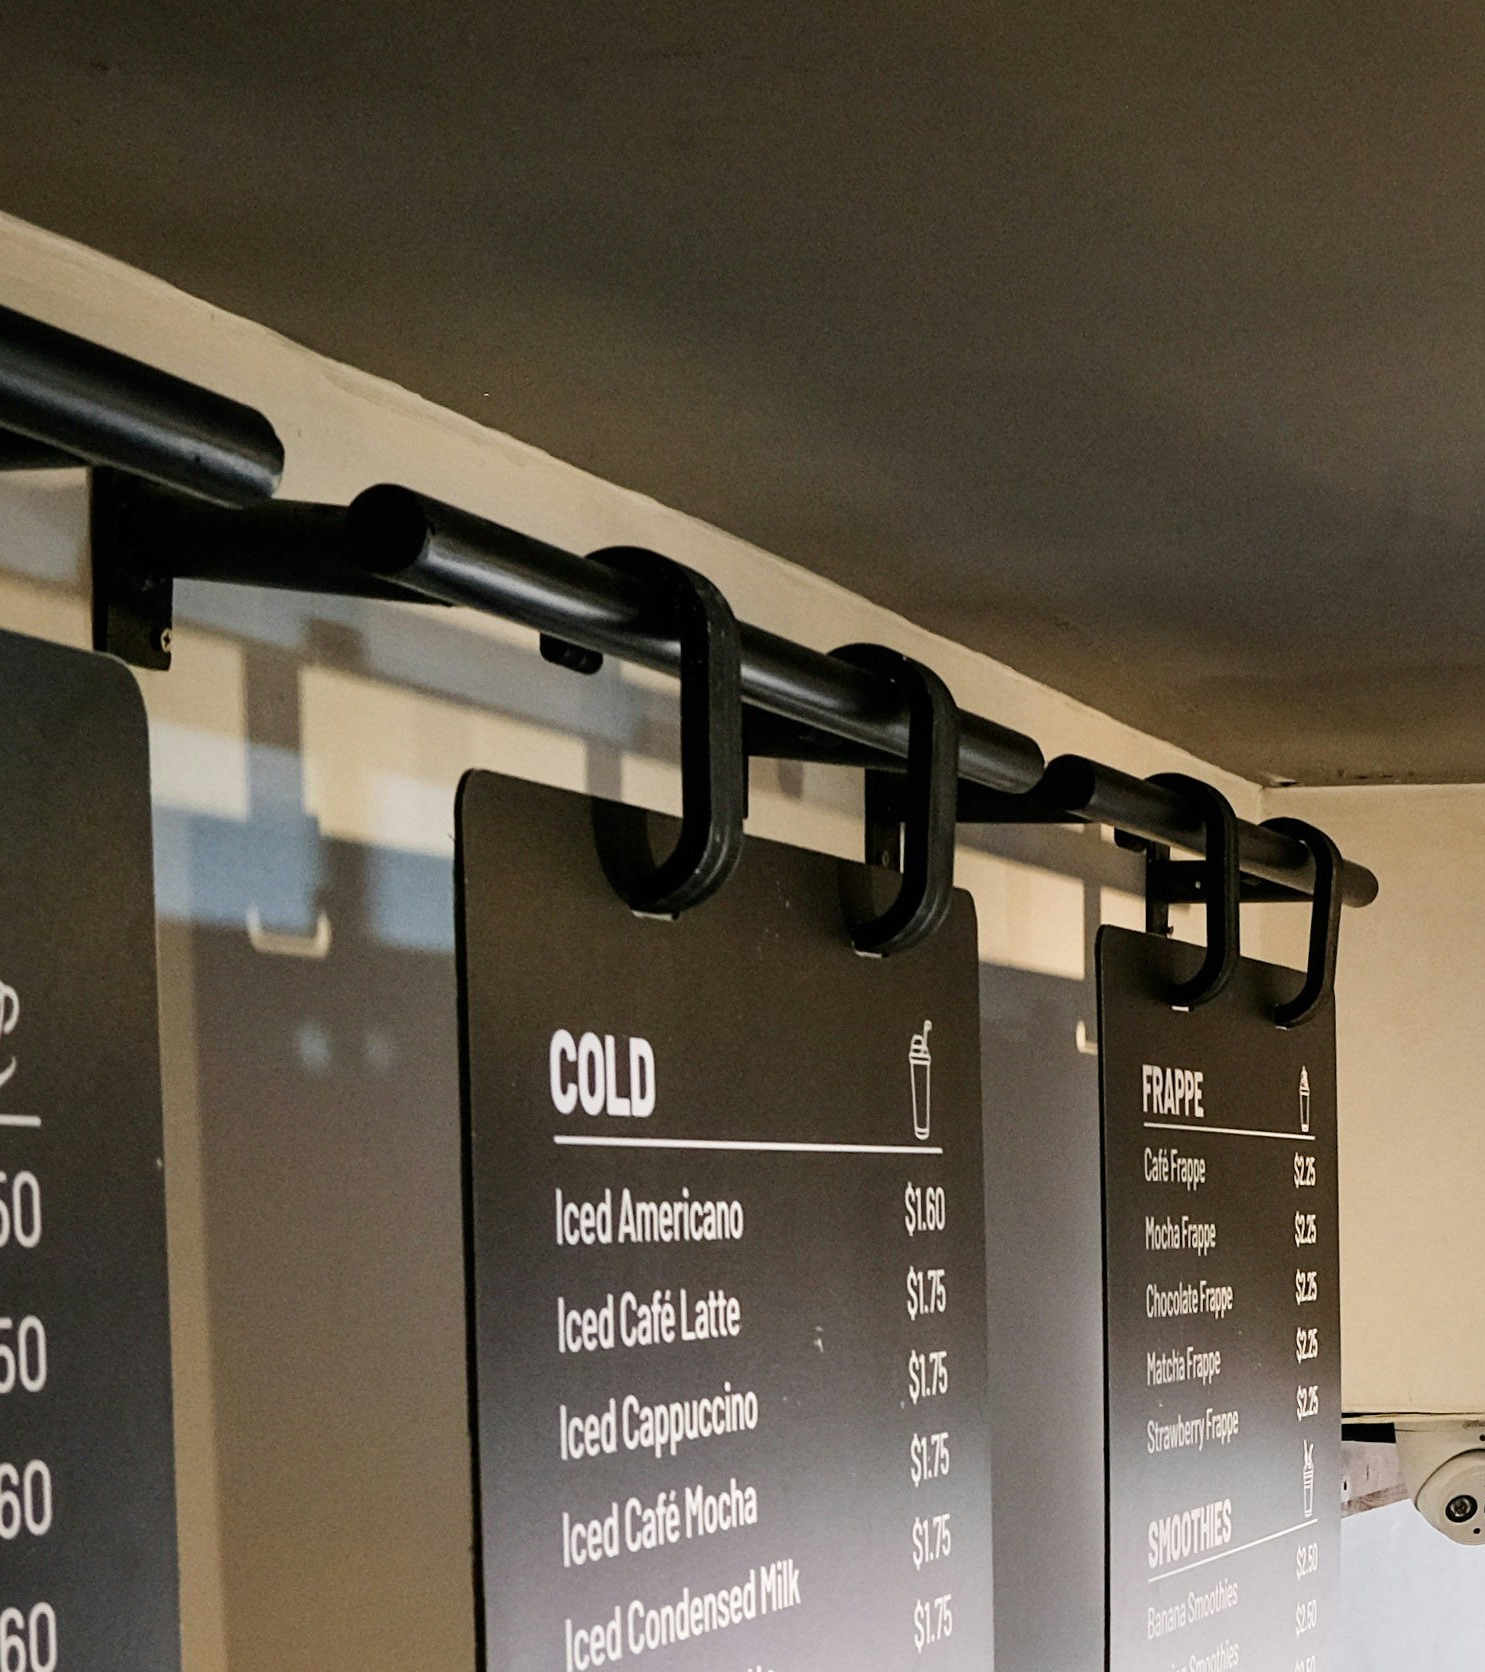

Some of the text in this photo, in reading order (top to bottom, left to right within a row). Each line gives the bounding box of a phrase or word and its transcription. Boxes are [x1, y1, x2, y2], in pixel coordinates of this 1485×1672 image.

[550, 1029, 655, 1117] COLD
[1142, 1064, 1204, 1118] FRAPPE
[1144, 1147, 1205, 1191] Café Frappe
[1294, 1152, 1316, 1189] $2.25
[555, 1187, 744, 1245] Iced Americano
[905, 1181, 946, 1237] $1.60
[1145, 1215, 1216, 1256] Mocha Frappe
[1295, 1211, 1317, 1247] $2.25
[906, 1265, 946, 1321] $1.75
[1146, 1280, 1233, 1319] Chocolate Frappe
[1295, 1269, 1317, 1305] $2.25
[557, 1288, 741, 1353] Iced Café Latte
[1296, 1327, 1318, 1364] $2.25
[908, 1349, 948, 1405] $1.75
[1147, 1346, 1221, 1386] Matcha Frappe
[559, 1381, 758, 1461] Iced Cappuccino
[1147, 1408, 1238, 1453] Strawberry Frappe
[1297, 1385, 1319, 1421] $2.25
[910, 1432, 950, 1487] $1.75
[562, 1478, 758, 1567] Iced Café Mocha
[912, 1513, 951, 1570] $1.75
[1149, 1499, 1231, 1568] SMOOTHIES
[1296, 1543, 1318, 1580] $2.50
[628, 1569, 756, 1654] Condensed
[760, 1558, 801, 1614] Milk
[914, 1594, 952, 1653] $1.75
[1147, 1578, 1238, 1640] Banana Smoothies
[1296, 1599, 1316, 1637] $2.50
